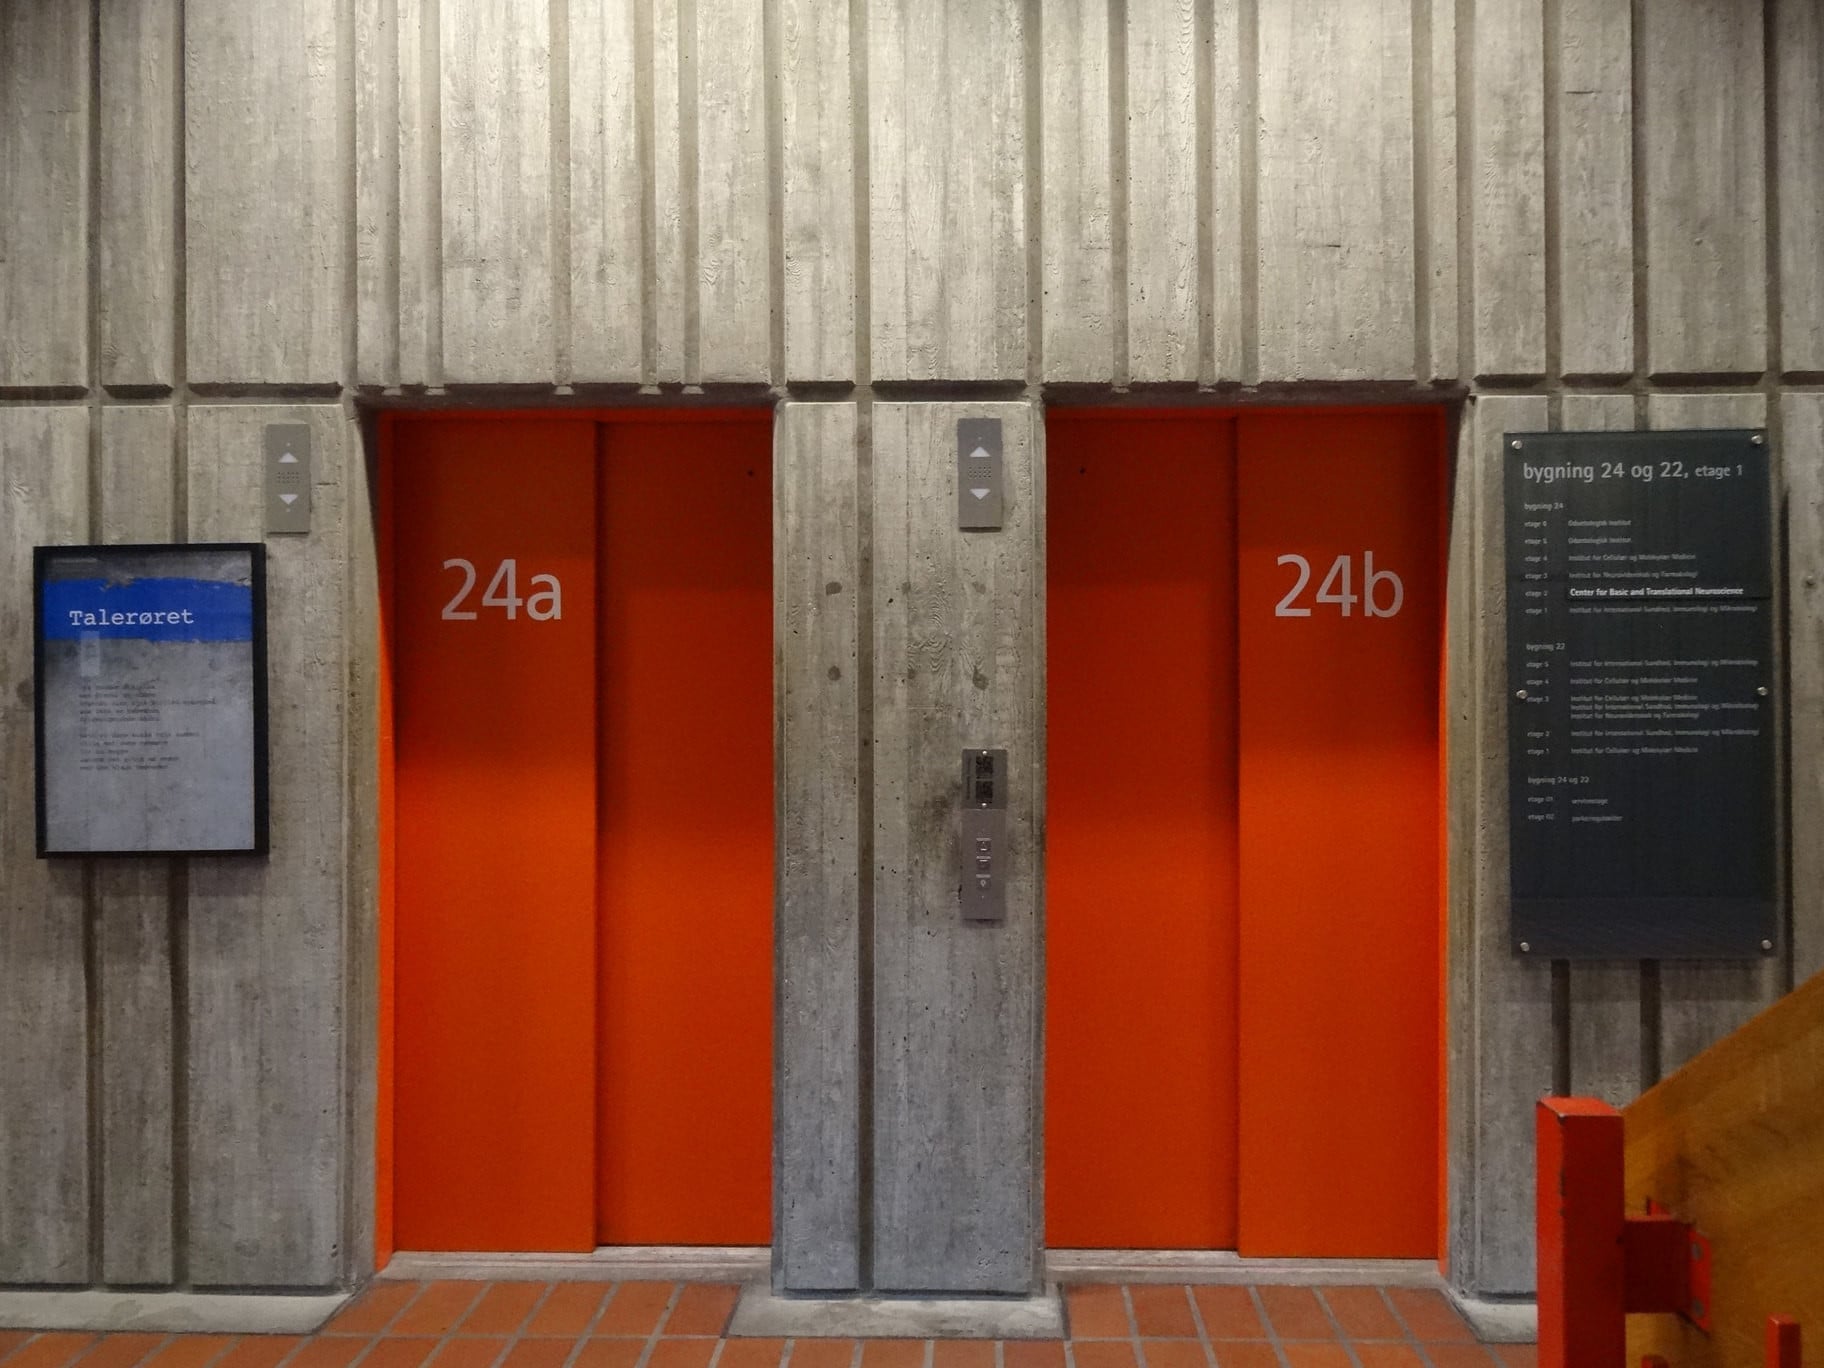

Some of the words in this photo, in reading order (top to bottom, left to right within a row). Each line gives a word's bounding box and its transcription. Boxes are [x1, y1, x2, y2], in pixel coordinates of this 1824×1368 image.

[1523, 462, 1594, 483] bygning
[1600, 462, 1625, 479] 24
[1630, 464, 1654, 482] og
[1659, 461, 1689, 479] 22,
[1694, 464, 1731, 480] etage
[1736, 464, 1743, 476] 1
[1554, 502, 1564, 510] 24
[442, 558, 561, 621] 24a
[1275, 550, 1404, 618] 24b
[1570, 588, 1595, 597] Center
[1596, 588, 1608, 596] for
[1609, 588, 1629, 596] Basic
[1630, 588, 1645, 596] and
[1646, 588, 1694, 596] Translational
[1694, 587, 1745, 595] Neuroscience
[69, 608, 195, 626] Talerøret
